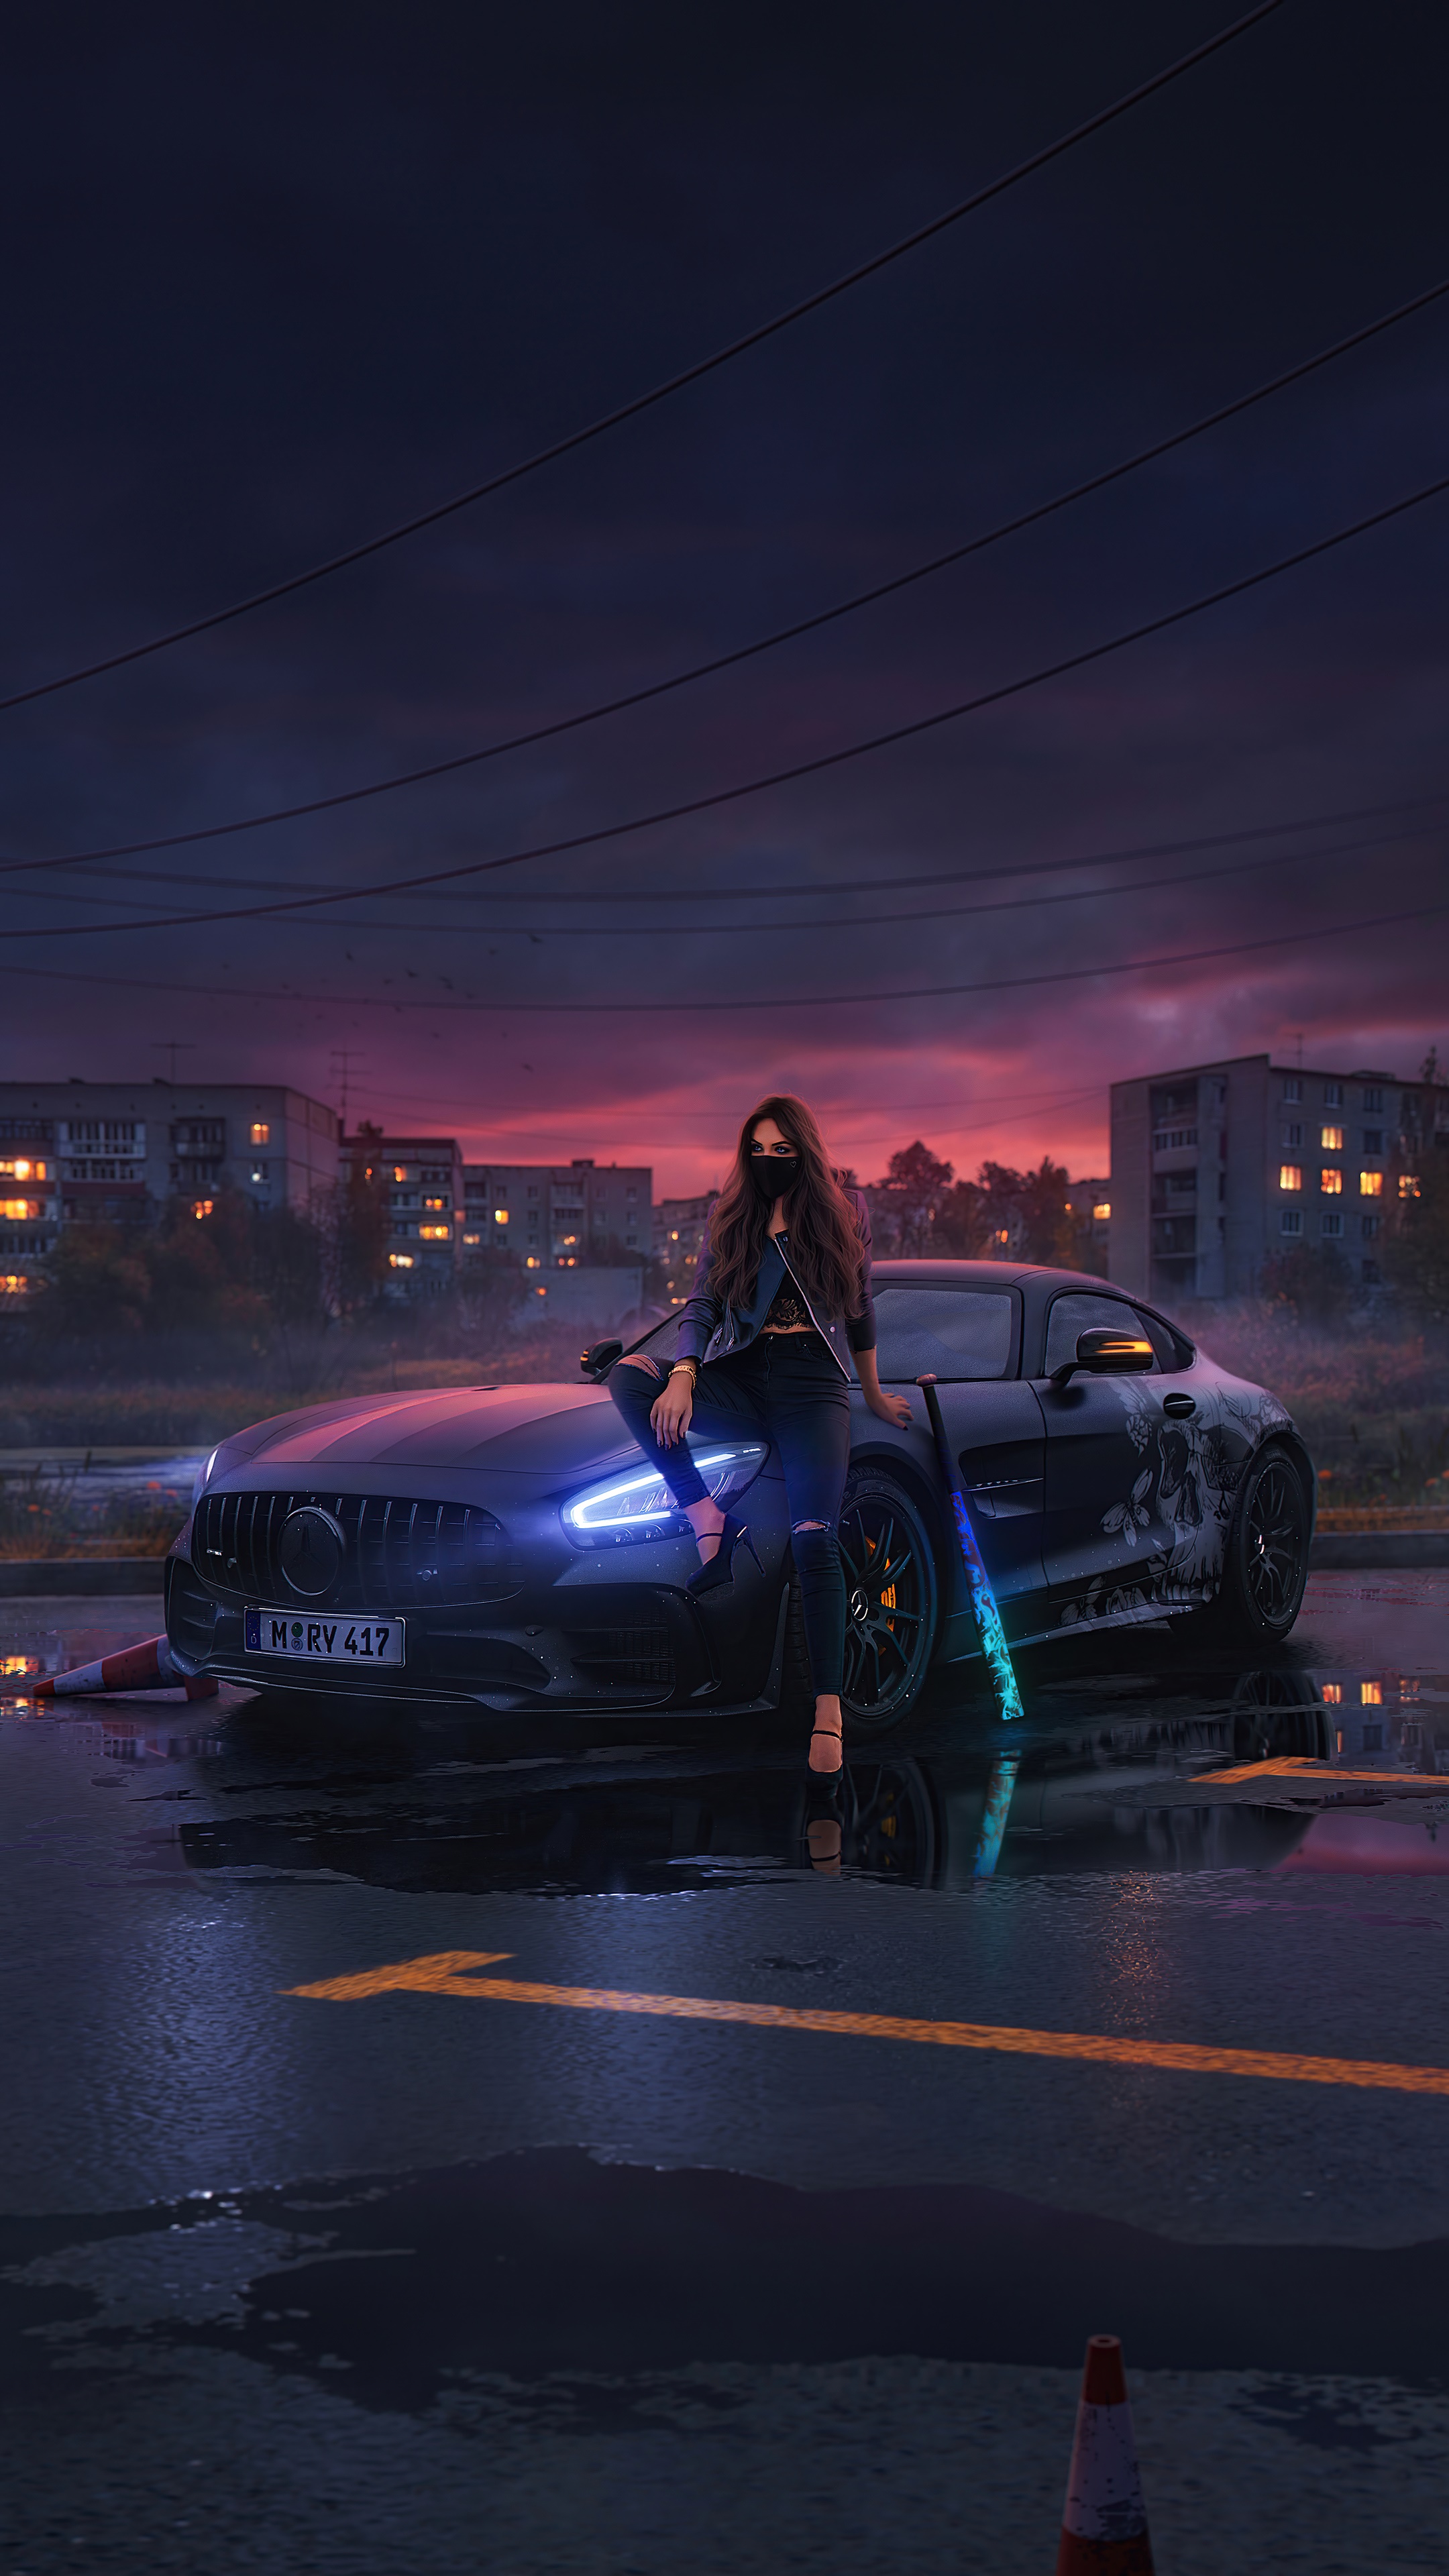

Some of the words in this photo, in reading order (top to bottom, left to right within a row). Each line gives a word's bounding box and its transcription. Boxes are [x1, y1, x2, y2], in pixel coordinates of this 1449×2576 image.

[250, 1635, 257, 1644] D
[272, 1620, 287, 1648] M
[307, 1623, 337, 1653] RY
[344, 1626, 390, 1656] 417
